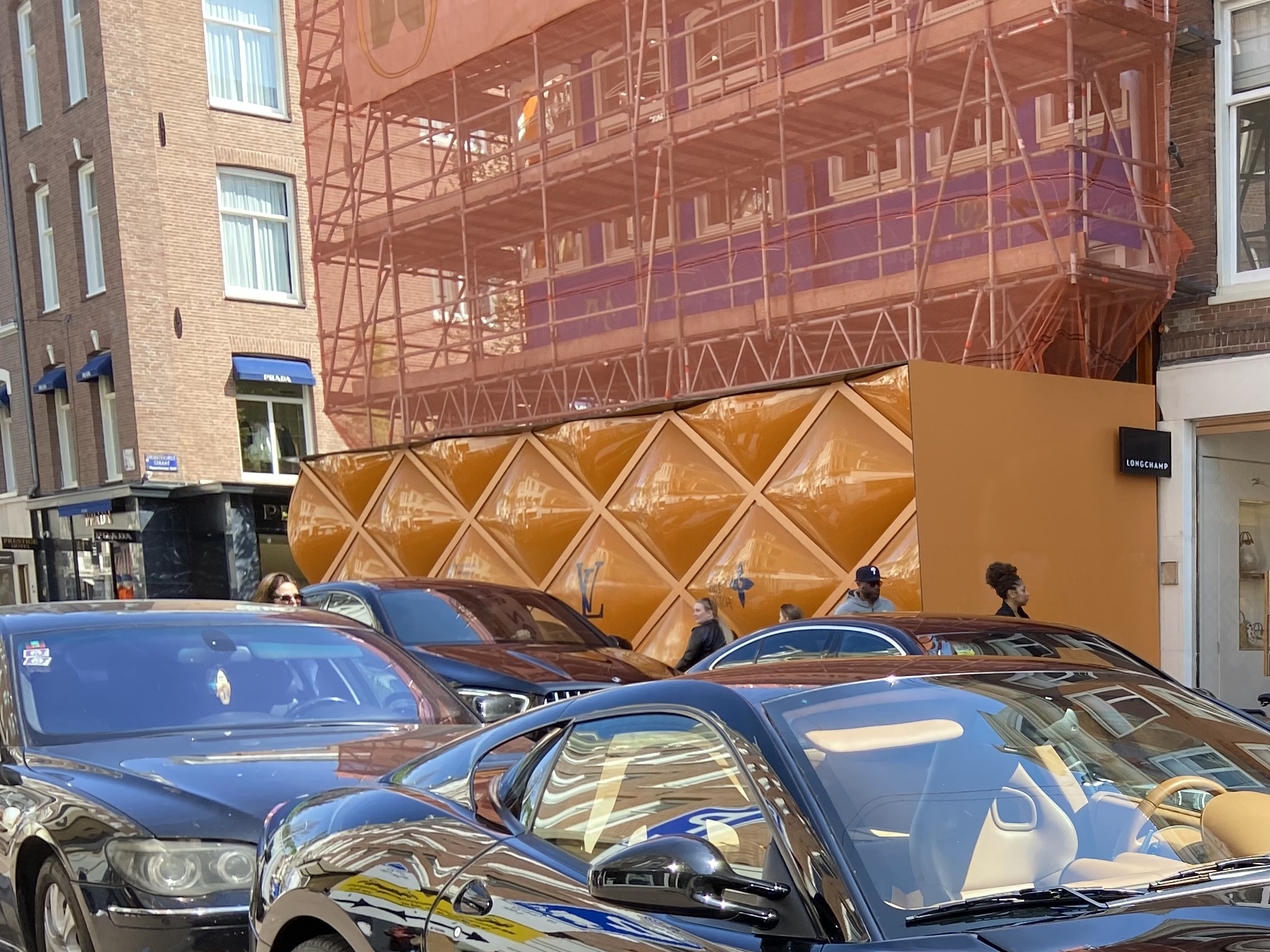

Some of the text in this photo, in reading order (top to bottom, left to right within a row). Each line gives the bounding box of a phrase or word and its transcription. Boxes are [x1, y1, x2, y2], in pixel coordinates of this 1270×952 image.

[263, 373, 292, 383] PRADA
[1126, 459, 1169, 470] LONGCHAMP
[95, 531, 133, 541] PRADA
